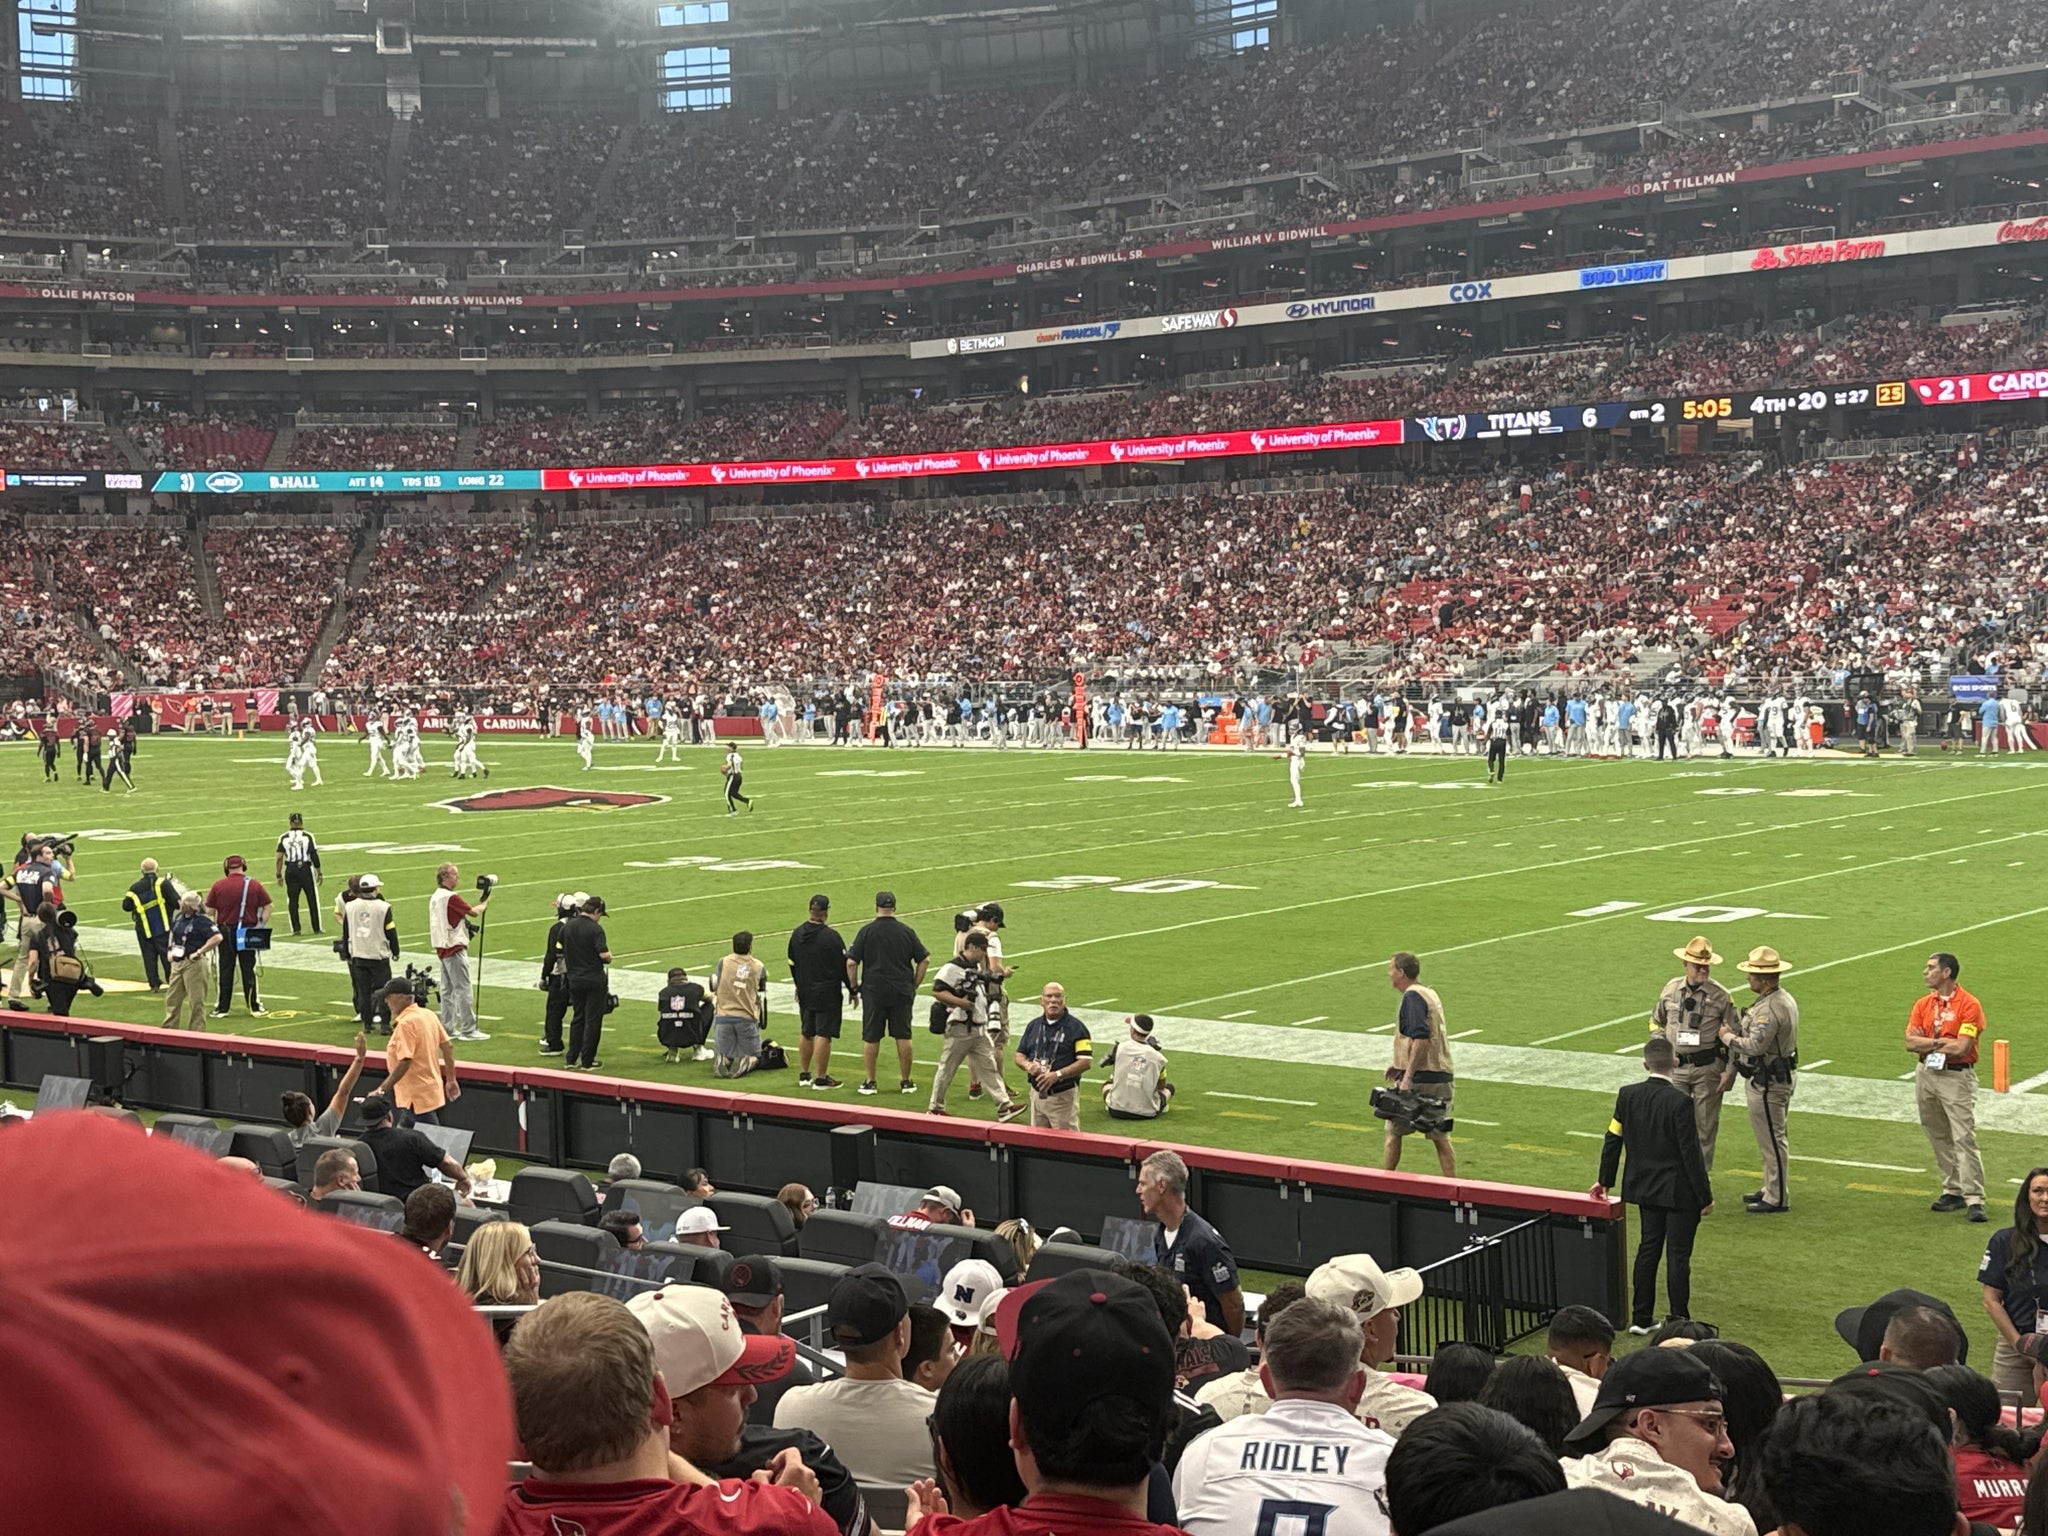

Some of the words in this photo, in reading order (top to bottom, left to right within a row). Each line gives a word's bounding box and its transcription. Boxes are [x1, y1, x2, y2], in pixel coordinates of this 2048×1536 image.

[1624, 184, 1640, 195] 40
[1643, 181, 1669, 194] PAT
[1673, 171, 1736, 189] TILLMAN
[1211, 234, 1261, 250] WILLIAM
[1264, 232, 1276, 243] V.
[1278, 225, 1328, 241] BIDWILL
[1016, 260, 1063, 273] CHARLES
[1065, 257, 1079, 267] W.
[1080, 252, 1127, 266] BIDWILL,
[1129, 249, 1147, 259] SR.
[1582, 270, 1615, 286] BUD
[1617, 263, 1665, 282] LIGHT
[42, 288, 79, 299] OLLIE
[82, 290, 135, 301] MATSON
[410, 296, 460, 305] AENEAS
[463, 295, 523, 305] WILLIAMS
[1450, 282, 1493, 302] COX
[1311, 297, 1375, 316] HYUNDAI
[1061, 323, 1104, 341] FINANCIAL
[1162, 312, 1220, 333] SAFEWAY
[959, 336, 1005, 351] BETMGM
[1848, 389, 1869, 404] 27
[1880, 387, 1902, 402] 25
[1938, 378, 1970, 401] 21
[1683, 398, 1732, 419] 5:05
[1750, 395, 1787, 413] 4TH
[1798, 391, 1827, 410] 20
[1487, 410, 1551, 430] TITANS
[1582, 408, 1593, 428] 6
[1651, 403, 1665, 422] 2
[1269, 433, 1320, 447] University
[1321, 429, 1333, 443] of
[1334, 427, 1376, 441] Phoenix
[995, 452, 1039, 466] University
[1039, 449, 1050, 462] of
[1050, 448, 1085, 461] Phoenix
[1127, 443, 1175, 457] University
[1175, 440, 1186, 453] of
[1187, 438, 1226, 452] Phoenix
[729, 466, 778, 480] University
[779, 465, 791, 477] of
[792, 464, 832, 476] Phoenix
[872, 461, 914, 474] University
[914, 459, 923, 470] of
[924, 457, 957, 470] Phoenix
[349, 477, 366, 487] ATT
[369, 475, 384, 488] 14
[402, 477, 421, 487] YDS
[424, 475, 441, 487] 113
[458, 476, 485, 486] LONG
[489, 474, 504, 486] 22
[586, 472, 635, 485] University
[635, 470, 647, 481] of
[648, 469, 686, 481] Phoenix
[2011, 701, 2018, 713] 6
[483, 718, 541, 730] CARDINA
[1565, 901, 1768, 923] 10
[955, 1284, 975, 1304] N
[1240, 1441, 1350, 1476] RIDLEY
[1973, 1479, 2029, 1498] MURR
